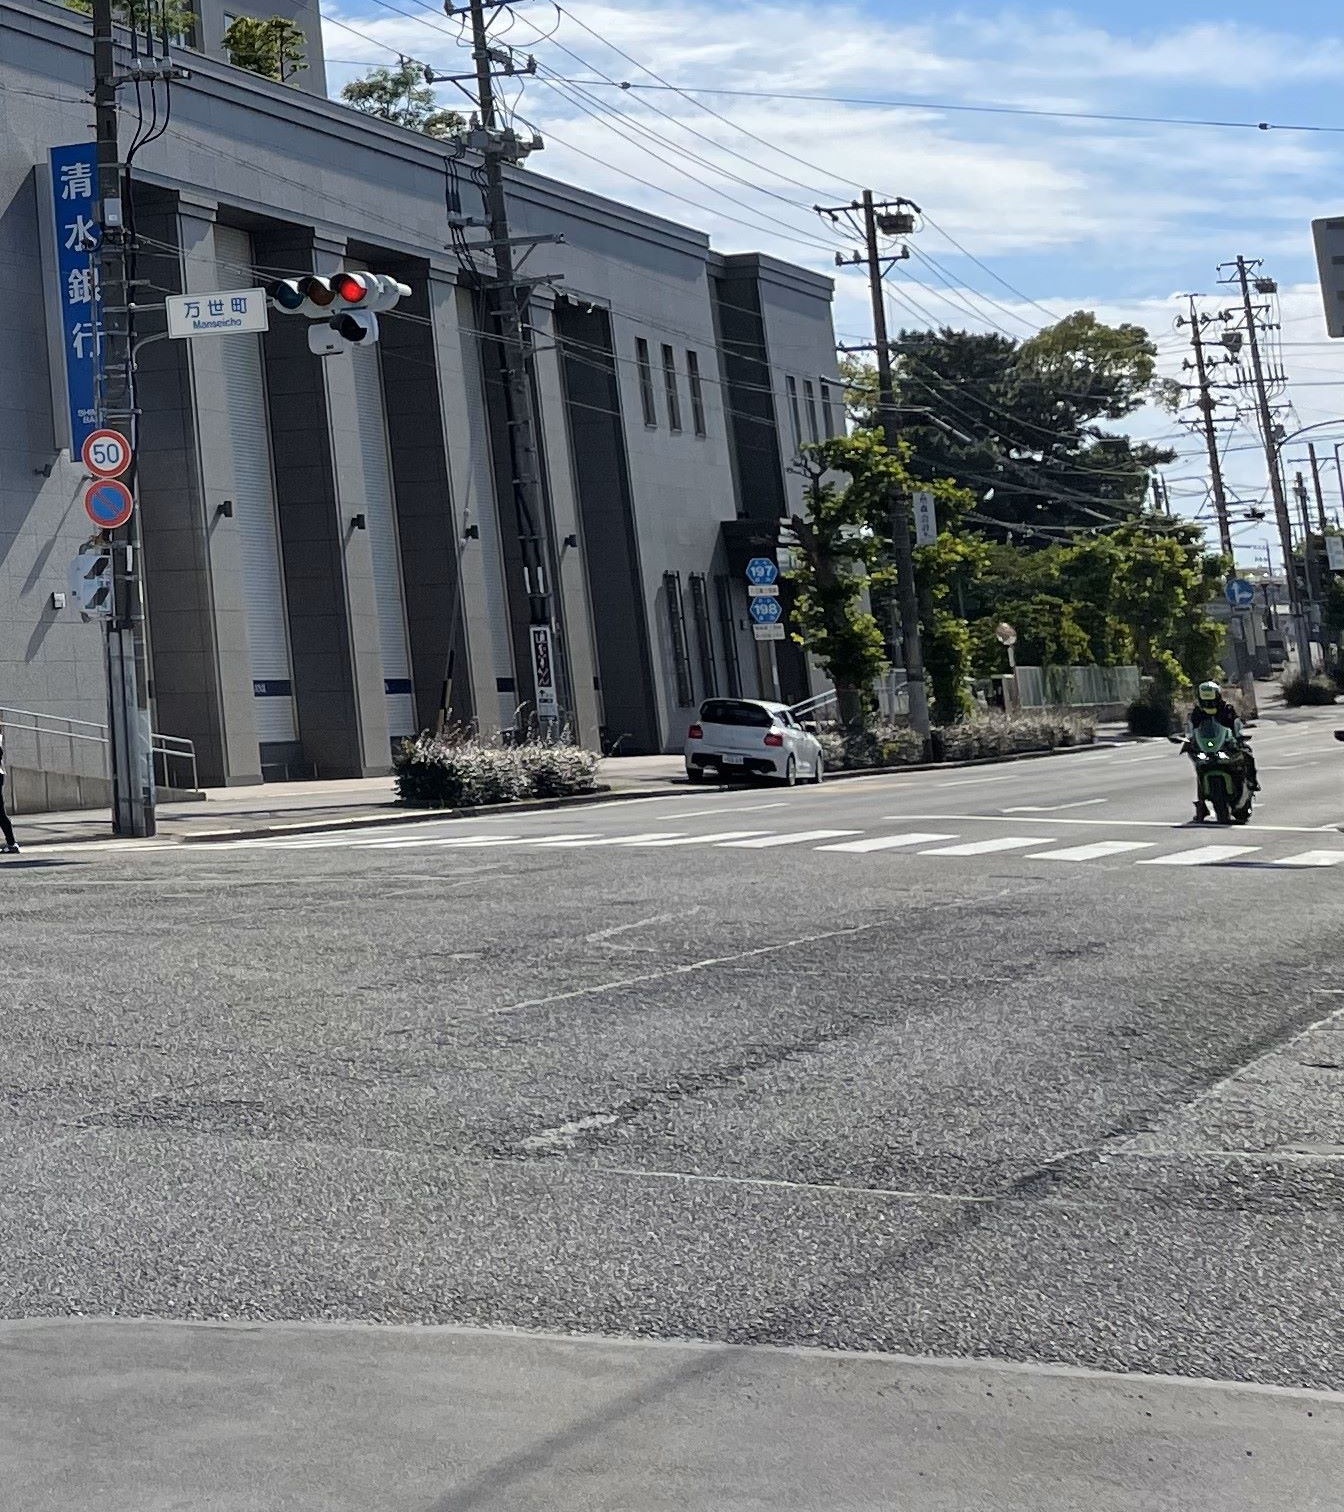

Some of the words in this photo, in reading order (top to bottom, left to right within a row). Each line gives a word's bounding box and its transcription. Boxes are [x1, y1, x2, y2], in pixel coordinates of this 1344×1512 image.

[60, 162, 105, 359] 清水銀行
[183, 297, 248, 319] 万世町
[192, 317, 242, 329] Manseicho
[92, 443, 120, 464] 50
[750, 565, 772, 577] 197
[754, 603, 777, 615] 198
